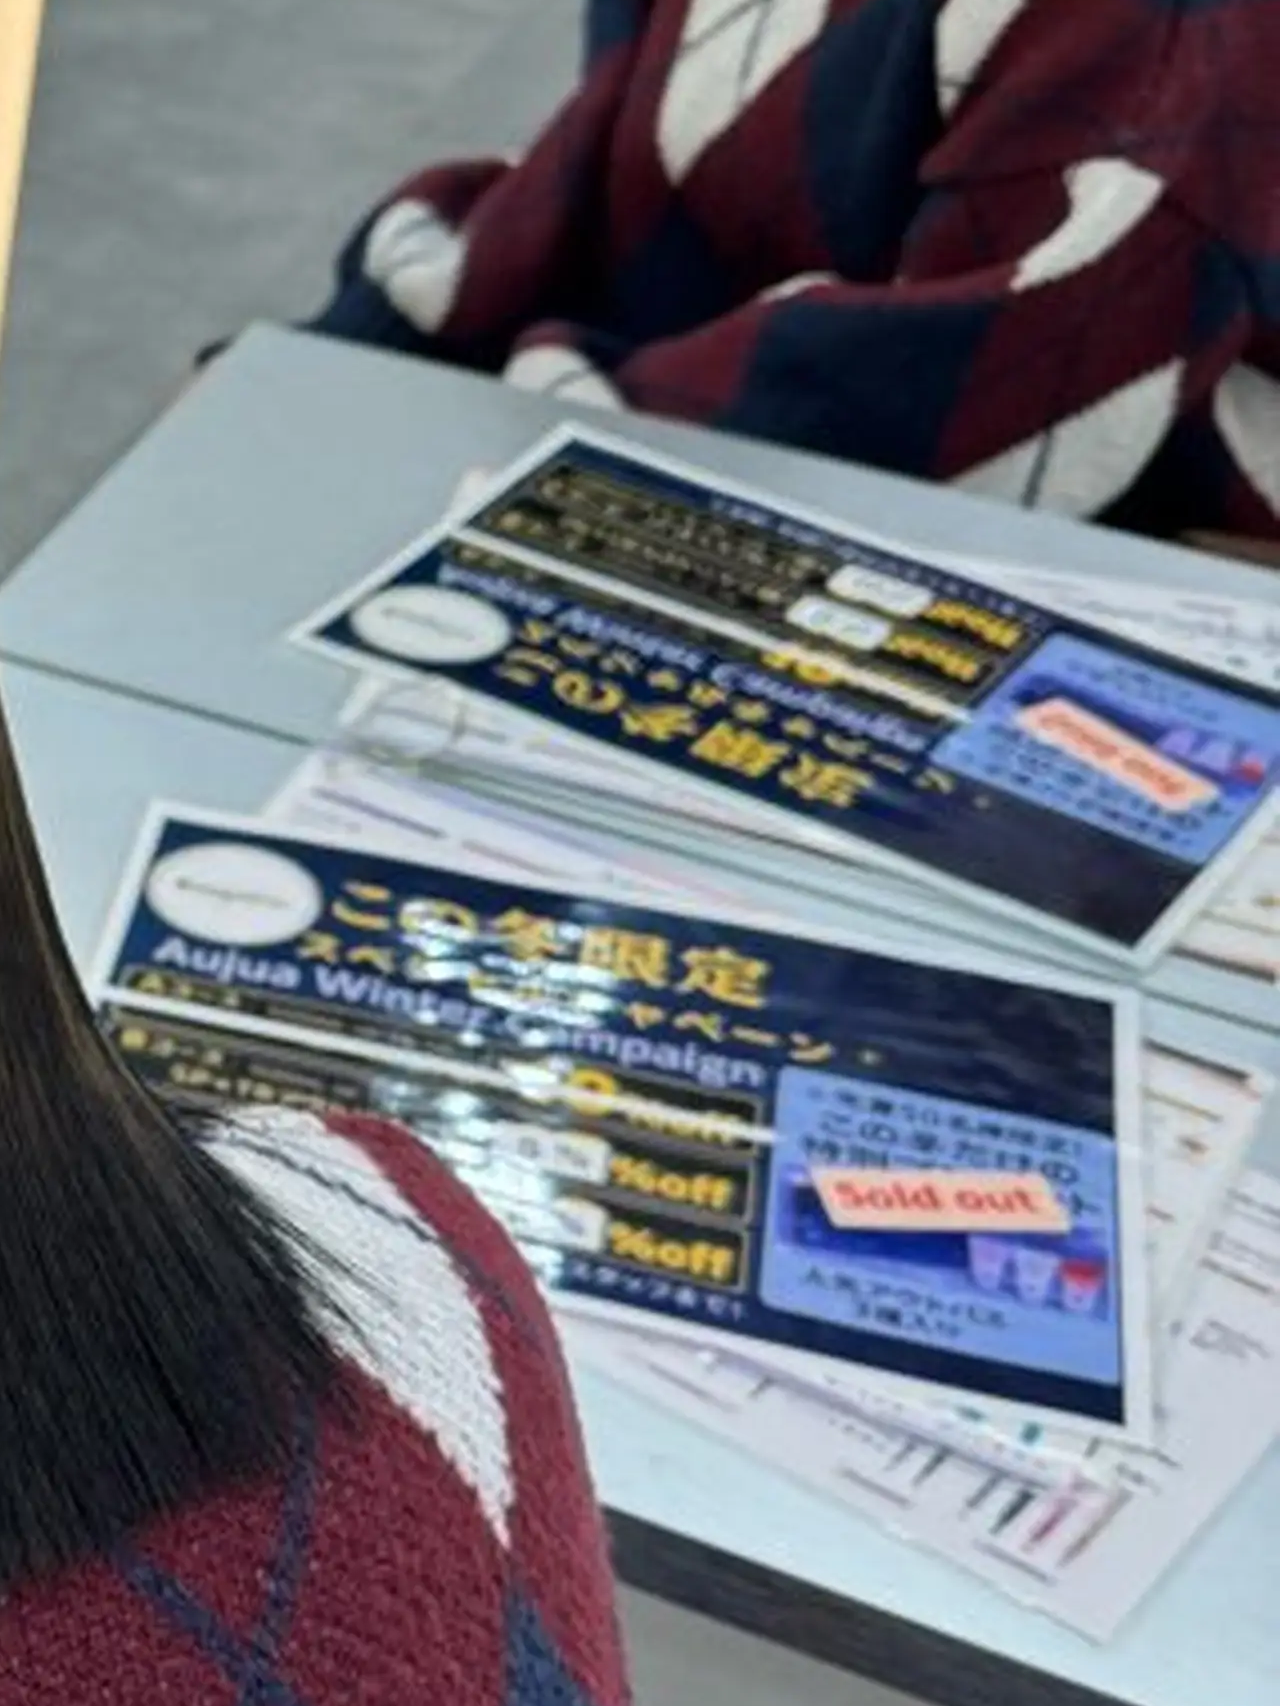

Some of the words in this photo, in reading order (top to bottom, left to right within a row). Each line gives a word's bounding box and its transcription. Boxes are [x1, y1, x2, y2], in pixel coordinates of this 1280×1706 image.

[330, 879, 772, 1009] この冬限定
[153, 936, 303, 991] Aujua
[314, 965, 493, 1031] Winter
[611, 1155, 734, 1210] %off
[834, 1180, 941, 1212] Sold
[953, 1187, 1042, 1215] out
[611, 1220, 735, 1282] %off
